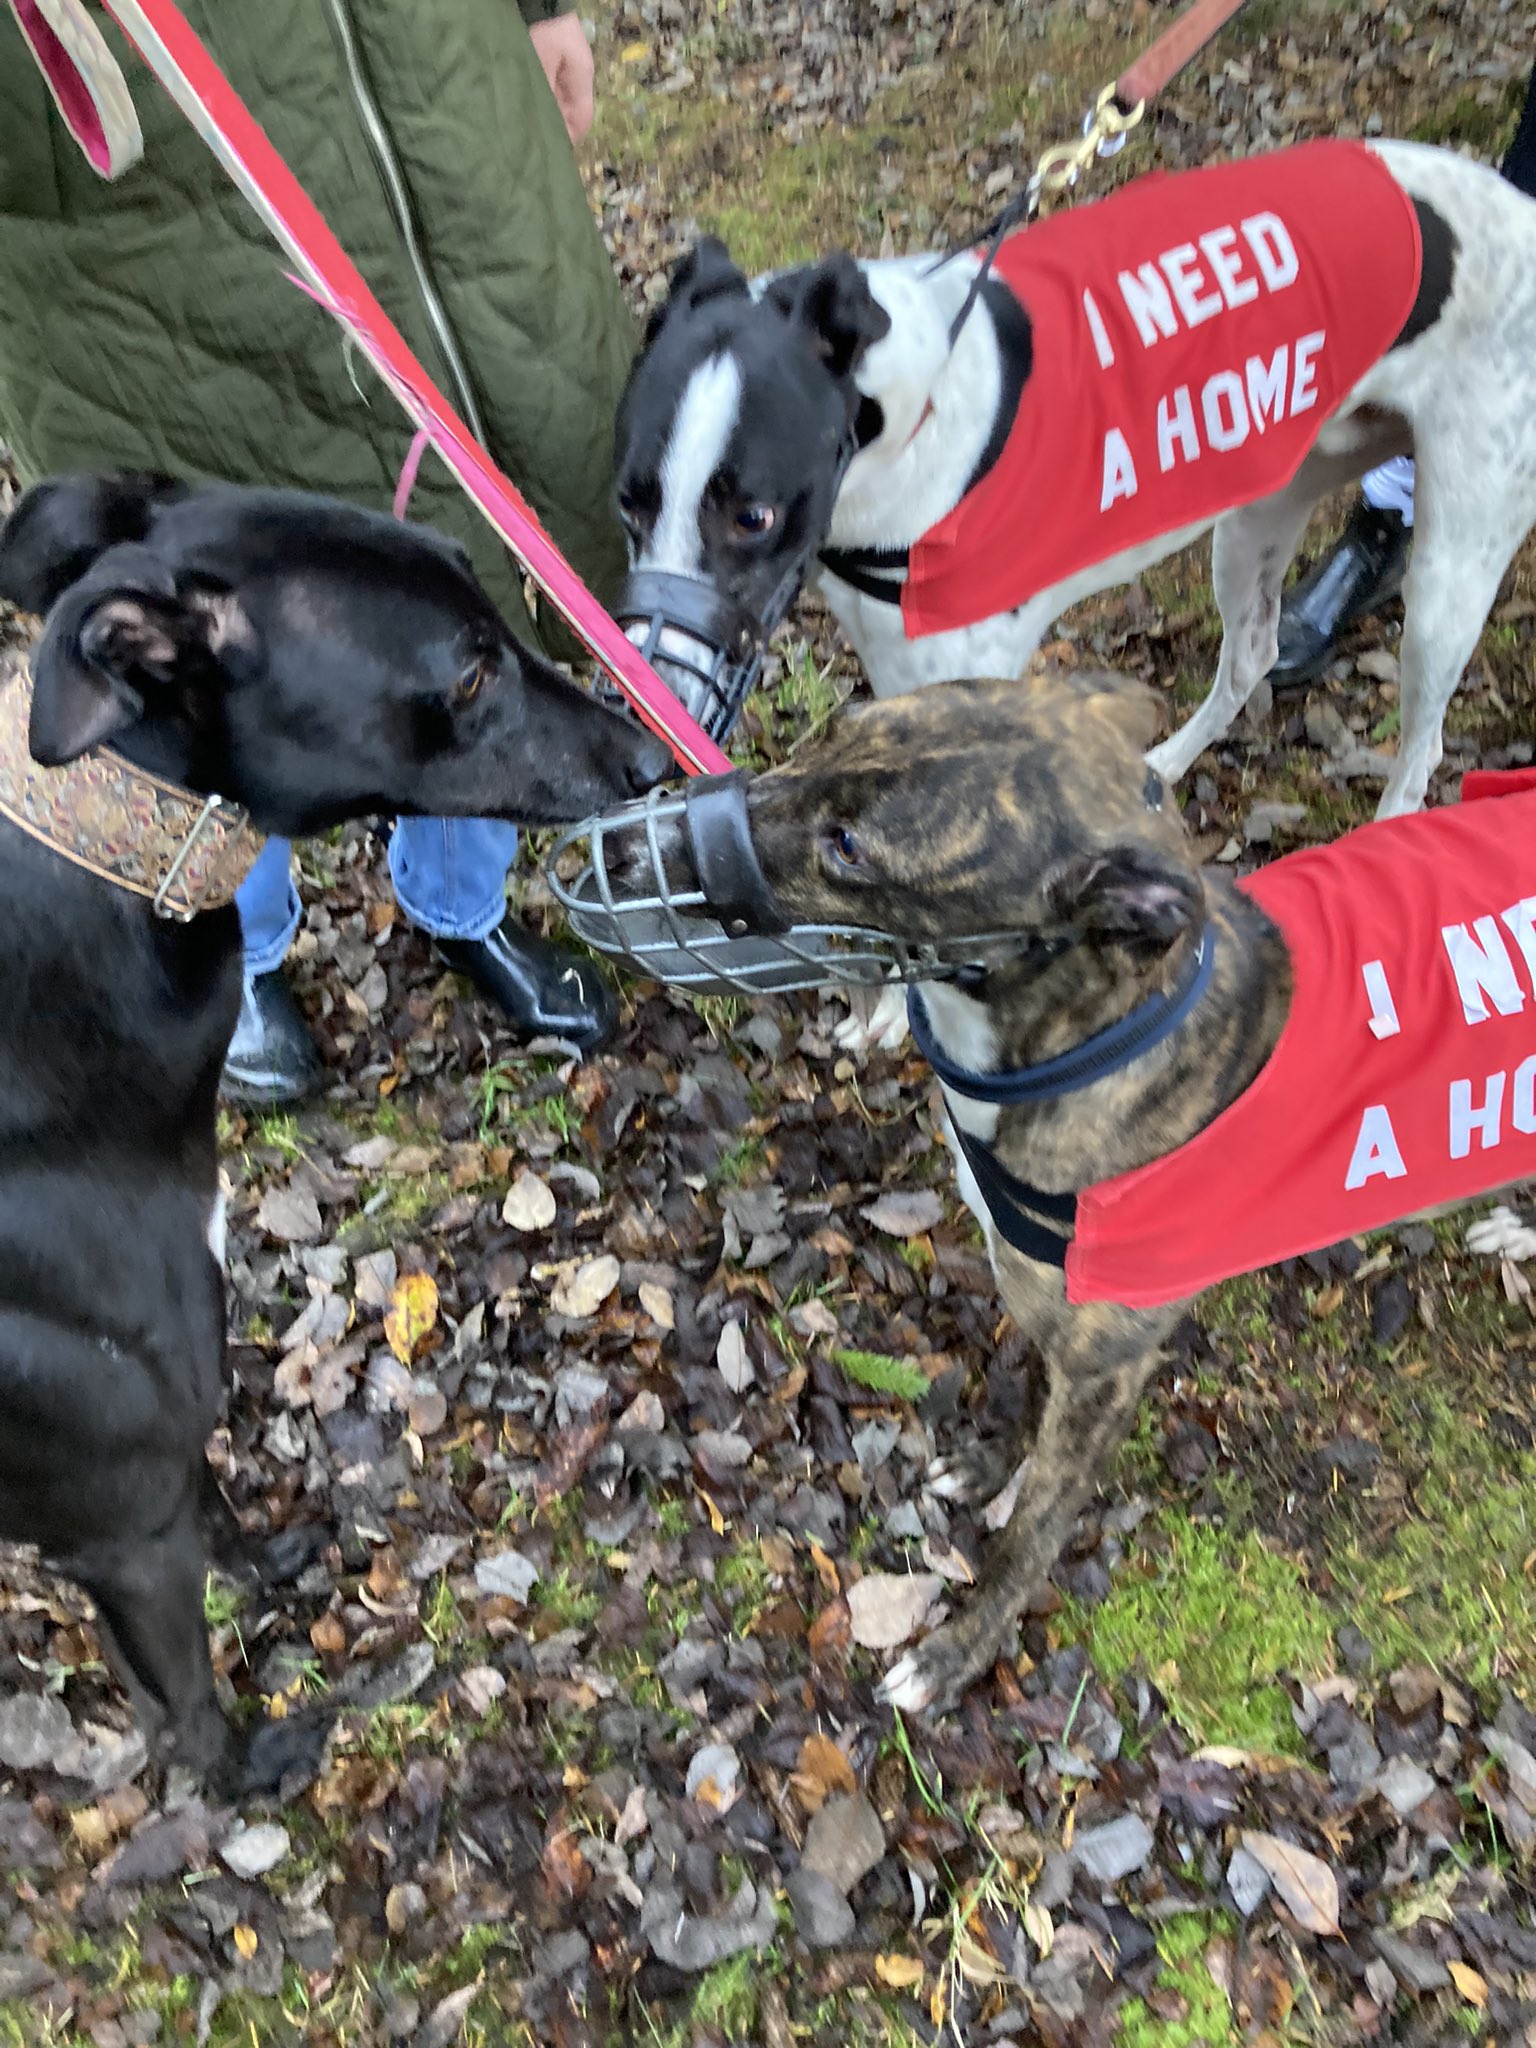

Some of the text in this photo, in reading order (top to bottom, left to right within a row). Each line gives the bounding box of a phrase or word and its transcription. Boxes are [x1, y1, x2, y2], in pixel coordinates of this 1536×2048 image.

[1083, 210, 1300, 370] I NEED
[1100, 329, 1326, 513] A HOME
[1361, 959, 1401, 1041] I
[1344, 1104, 1408, 1191] A
